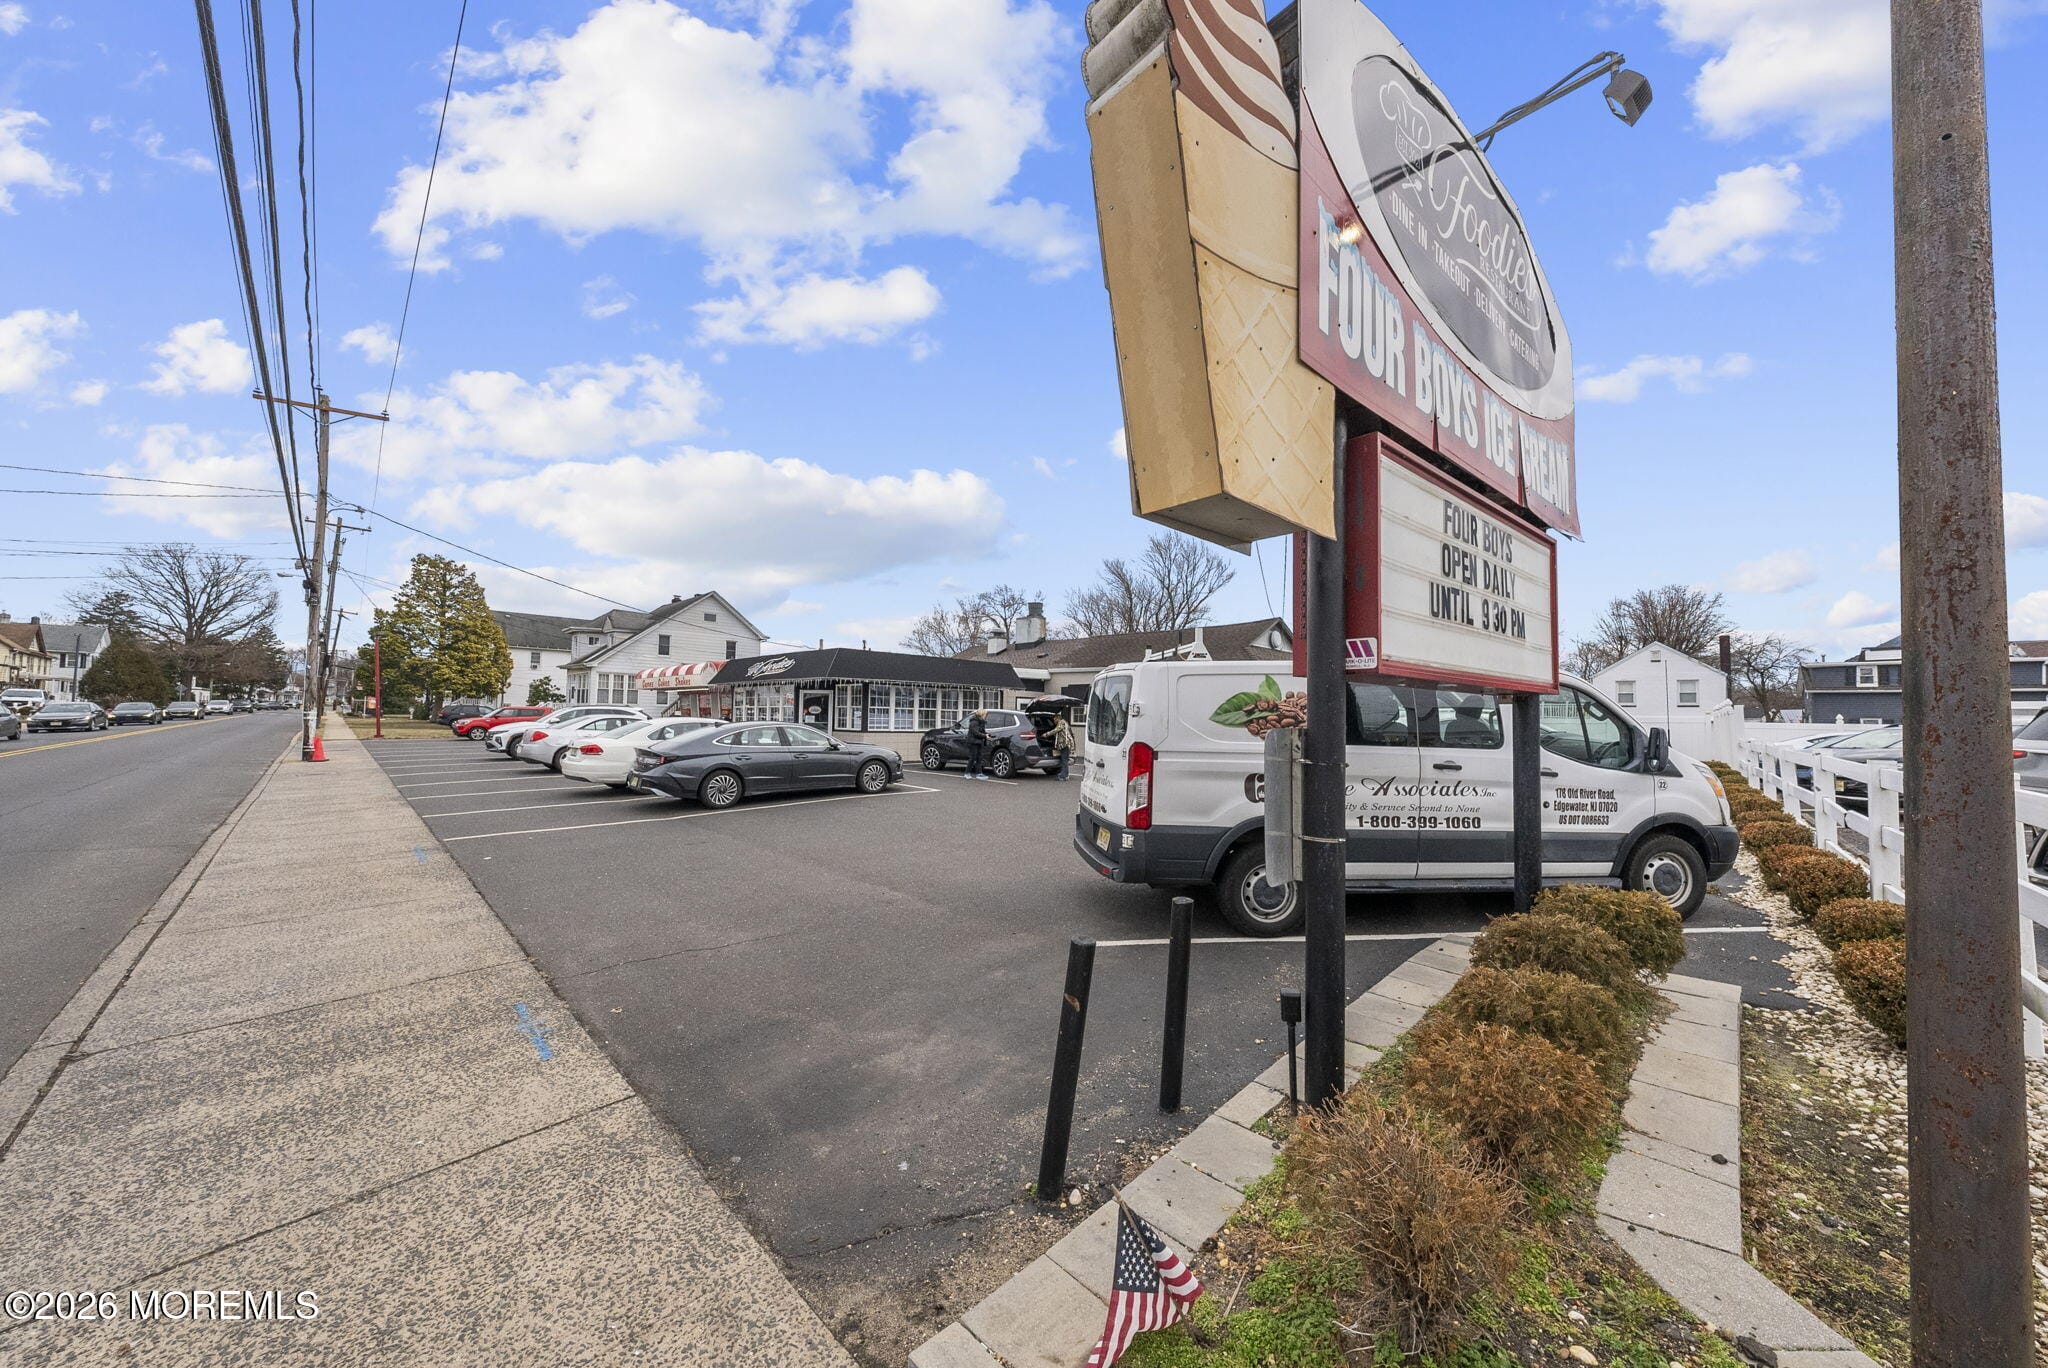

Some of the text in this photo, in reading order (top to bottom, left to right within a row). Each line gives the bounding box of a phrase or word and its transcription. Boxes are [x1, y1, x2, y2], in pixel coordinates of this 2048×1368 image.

[1429, 143, 1541, 302] Foodies
[1392, 190, 1415, 237] DINE
[1418, 221, 1428, 250] IN
[1433, 240, 1471, 297] TAKEOUT
[1475, 287, 1506, 337] DELIVERY
[1510, 329, 1540, 371] CATERING
[1480, 256, 1531, 321] RESTAURANT
[1318, 196, 1570, 516] FOUR BOYS ICE CREAM
[1443, 499, 1513, 564] FOUR BOYS
[1441, 542, 1516, 600] OPEN DAILY
[1429, 581, 1474, 626] UNTIL
[1511, 609, 1526, 639] PM
[1360, 802, 1368, 811] &
[1371, 803, 1405, 812] Service
[1409, 803, 1442, 813] Second
[1444, 803, 1453, 813] to
[1457, 804, 1481, 813] None
[1361, 776, 1479, 797] Associates
[1480, 788, 1496, 798] Inc
[1554, 800, 1618, 813] Edgewater, NJ 07020
[1567, 788, 1578, 799] Old
[1580, 788, 1596, 799] River
[1356, 815, 1481, 829] 1-800-399-1060
[1559, 815, 1567, 825] US
[1568, 815, 1580, 825] DOT
